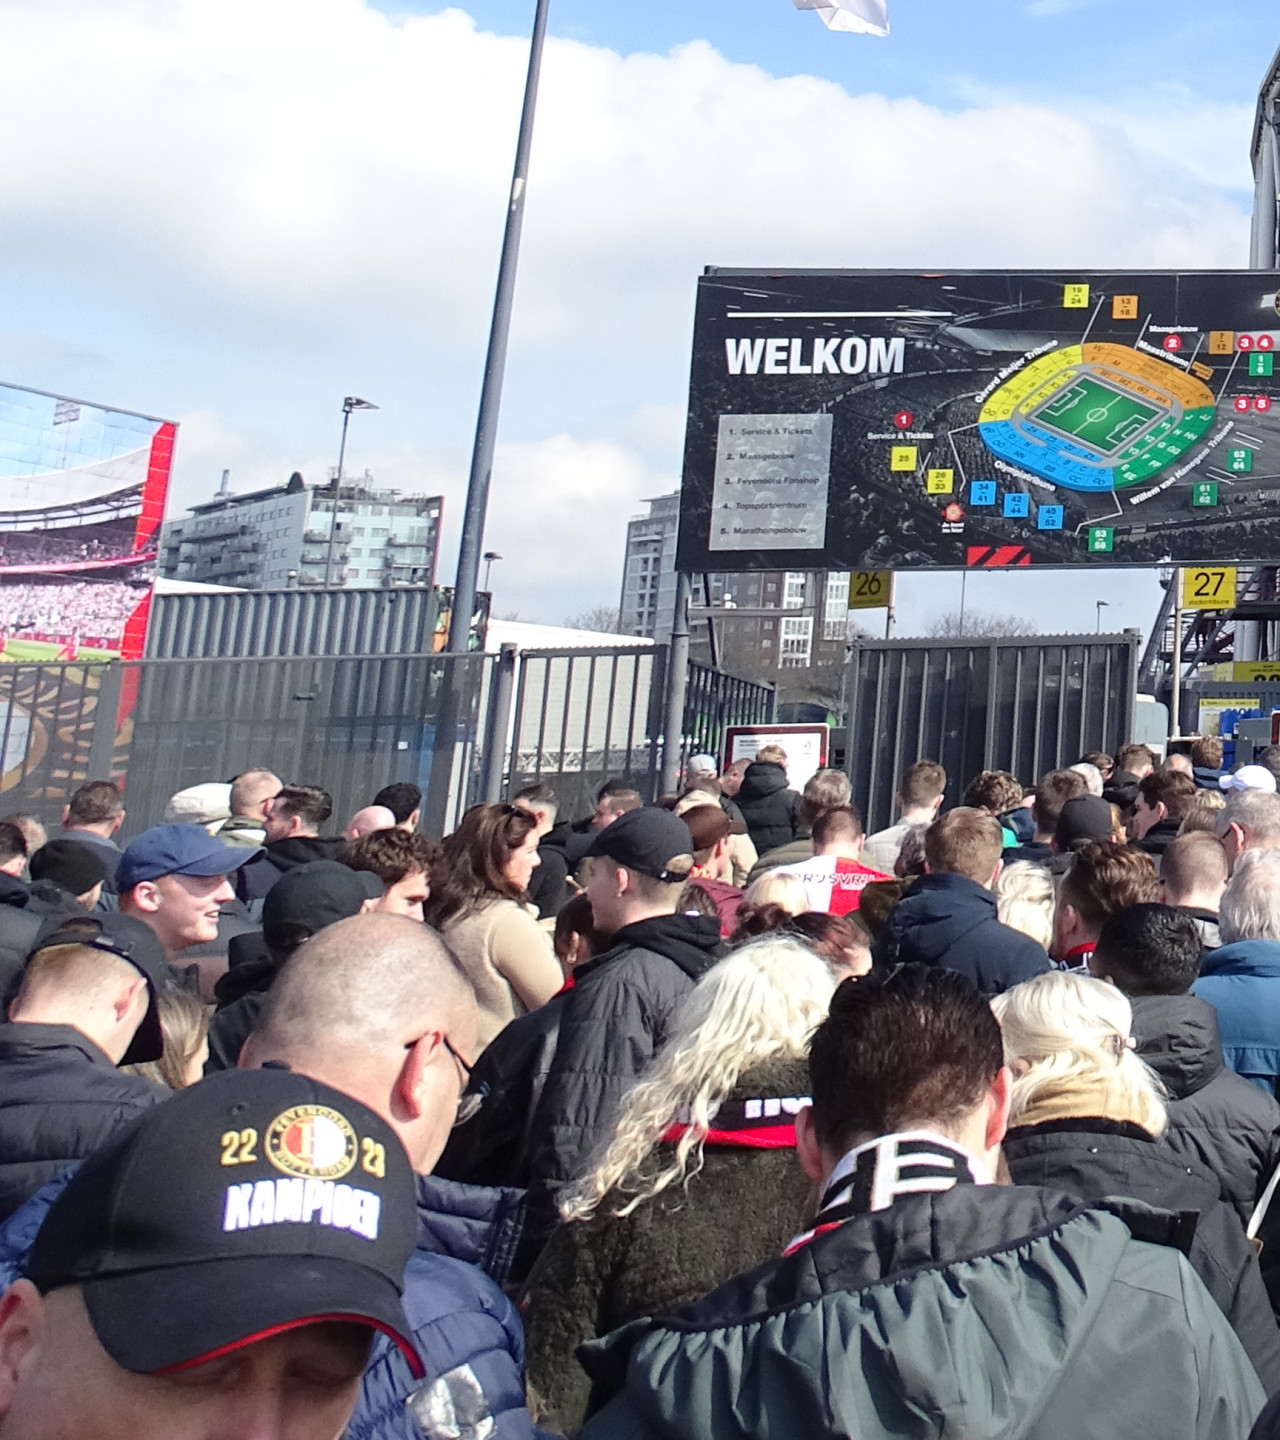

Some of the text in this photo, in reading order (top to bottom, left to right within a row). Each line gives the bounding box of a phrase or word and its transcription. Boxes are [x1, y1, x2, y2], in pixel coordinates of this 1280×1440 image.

[1168, 339, 1178, 348] 2
[1240, 338, 1249, 347] 3
[1260, 338, 1269, 346] 4
[1024, 340, 1058, 359] Tribune
[725, 337, 906, 375] WELKOM
[1238, 400, 1247, 408] 3
[1258, 400, 1266, 408] 5
[1233, 450, 1246, 458] 63
[1129, 485, 1160, 506] Willem
[1160, 476, 1176, 490] van
[1208, 420, 1235, 448] Tribune
[1232, 462, 1246, 470] 64
[1200, 484, 1210, 492] 61
[1200, 496, 1211, 504] 62
[856, 572, 882, 596] 26
[1194, 572, 1225, 596] 27
[220, 1127, 258, 1166] 22
